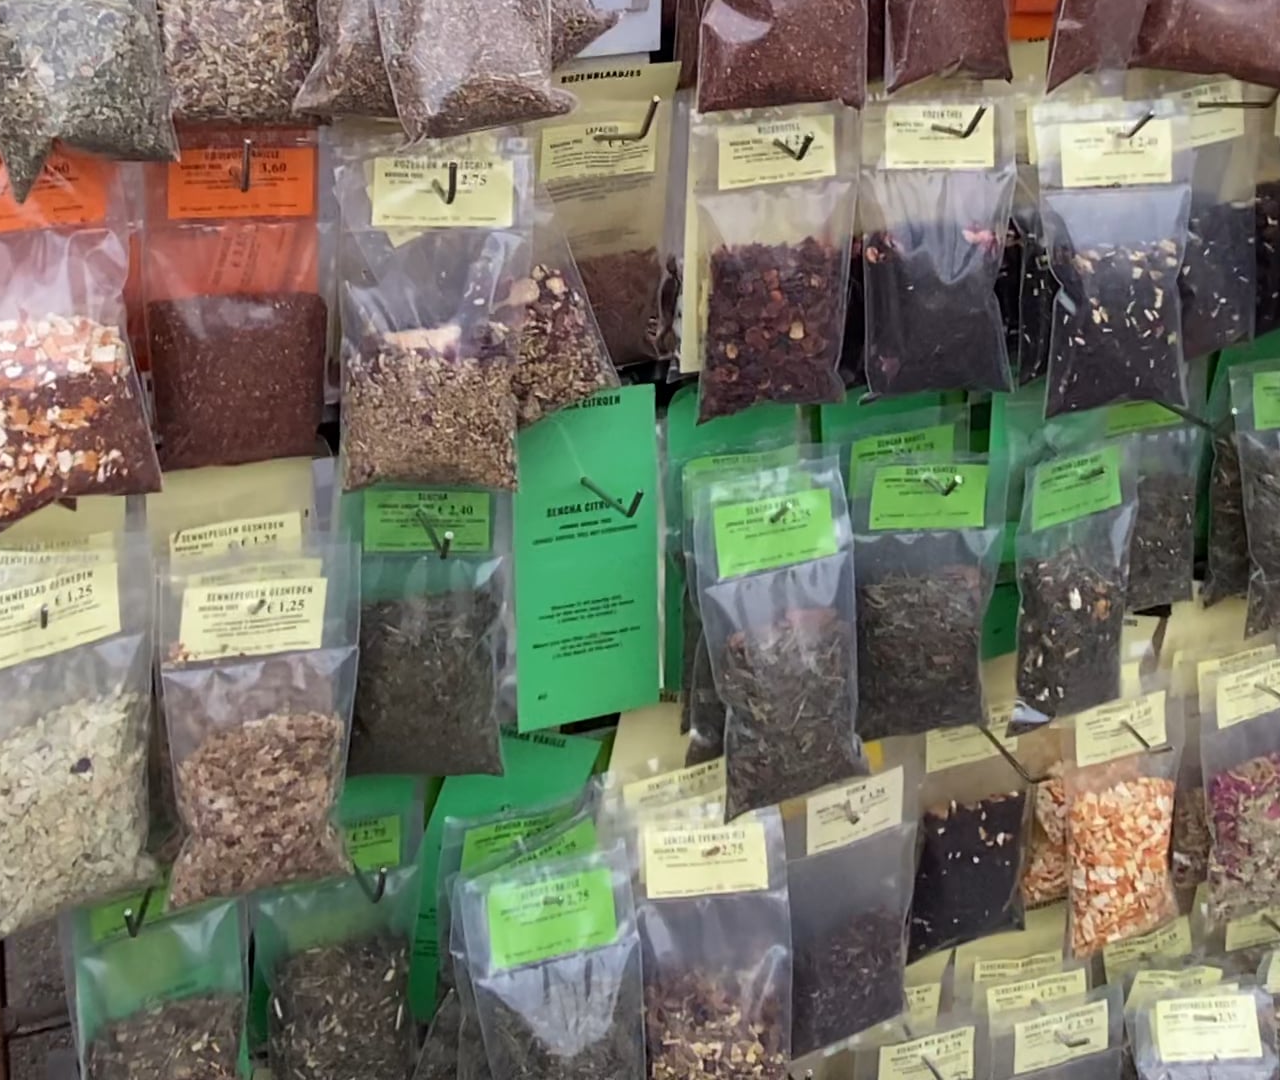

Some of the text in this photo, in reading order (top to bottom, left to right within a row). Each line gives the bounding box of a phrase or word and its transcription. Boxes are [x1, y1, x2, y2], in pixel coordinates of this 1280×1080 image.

[582, 395, 621, 409] CITROEN
[547, 504, 583, 518] SENCHA
[182, 521, 284, 543] SENNEPEULEN GESNEDEN
[49, 570, 93, 591] GESNEDEN
[55, 584, 93, 606] € 1,25
[207, 585, 313, 602] SENNEPEULEN GESNEDEN
[280, 600, 305, 613] 1,25
